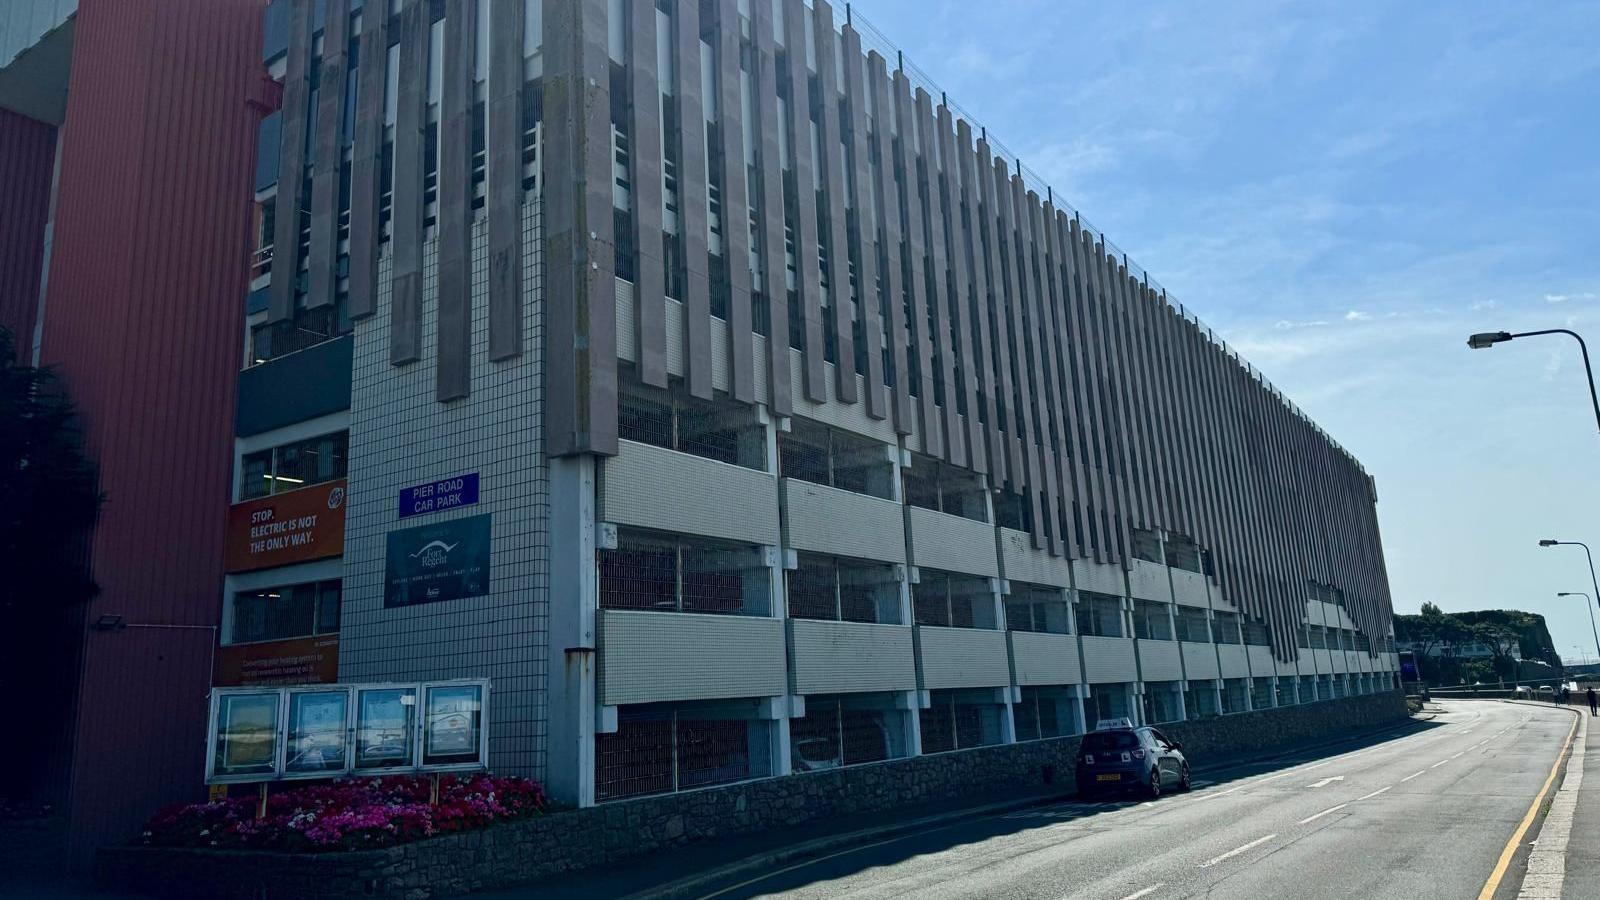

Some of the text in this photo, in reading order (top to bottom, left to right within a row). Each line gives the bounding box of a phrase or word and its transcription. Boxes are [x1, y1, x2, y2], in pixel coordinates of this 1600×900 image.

[413, 478, 464, 499] PIER ROAD
[414, 492, 462, 513] CAR PARK
[251, 515, 317, 538] ELECTRIC IS NOT
[252, 509, 274, 523] STOP.
[250, 531, 314, 554] THE ONLY WAY.
[422, 554, 447, 568] Regent
[427, 548, 442, 559] Fort
